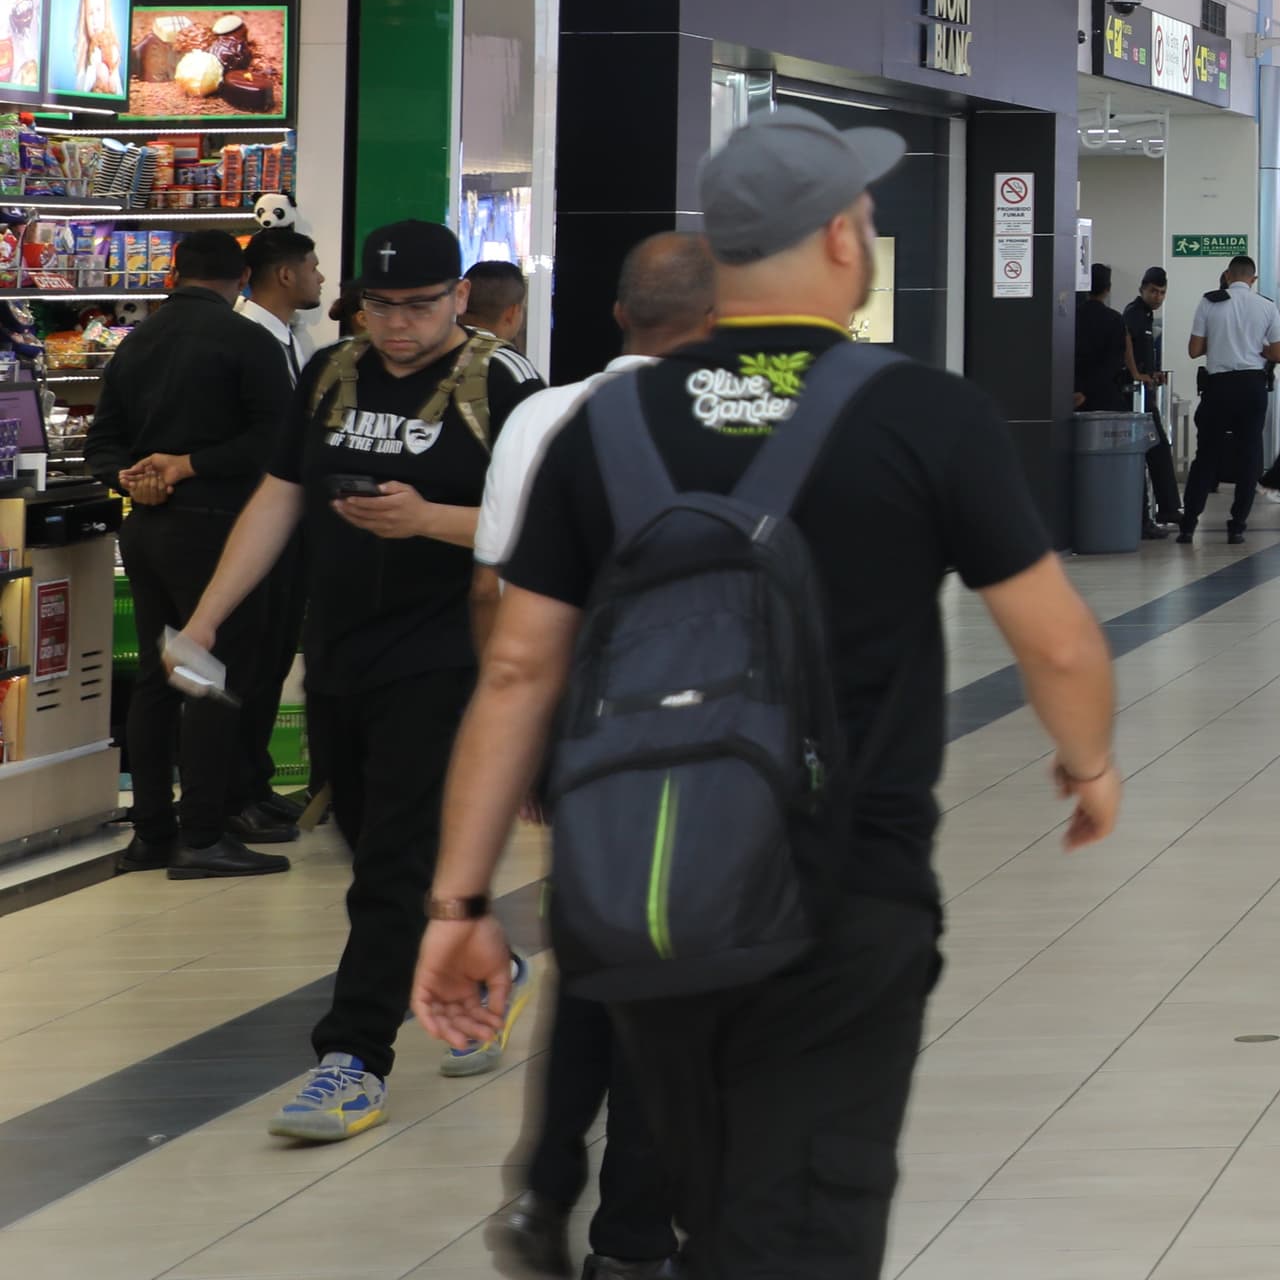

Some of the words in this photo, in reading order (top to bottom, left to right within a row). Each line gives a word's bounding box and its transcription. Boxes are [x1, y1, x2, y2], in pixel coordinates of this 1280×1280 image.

[934, 23, 973, 77] BLANC
[1203, 237, 1246, 246] SALIDA
[34, 276, 74, 290] OFERTA
[686, 368, 768, 395] Olive
[327, 432, 346, 447] OF
[348, 434, 374, 452] THE
[375, 439, 404, 454] LORD
